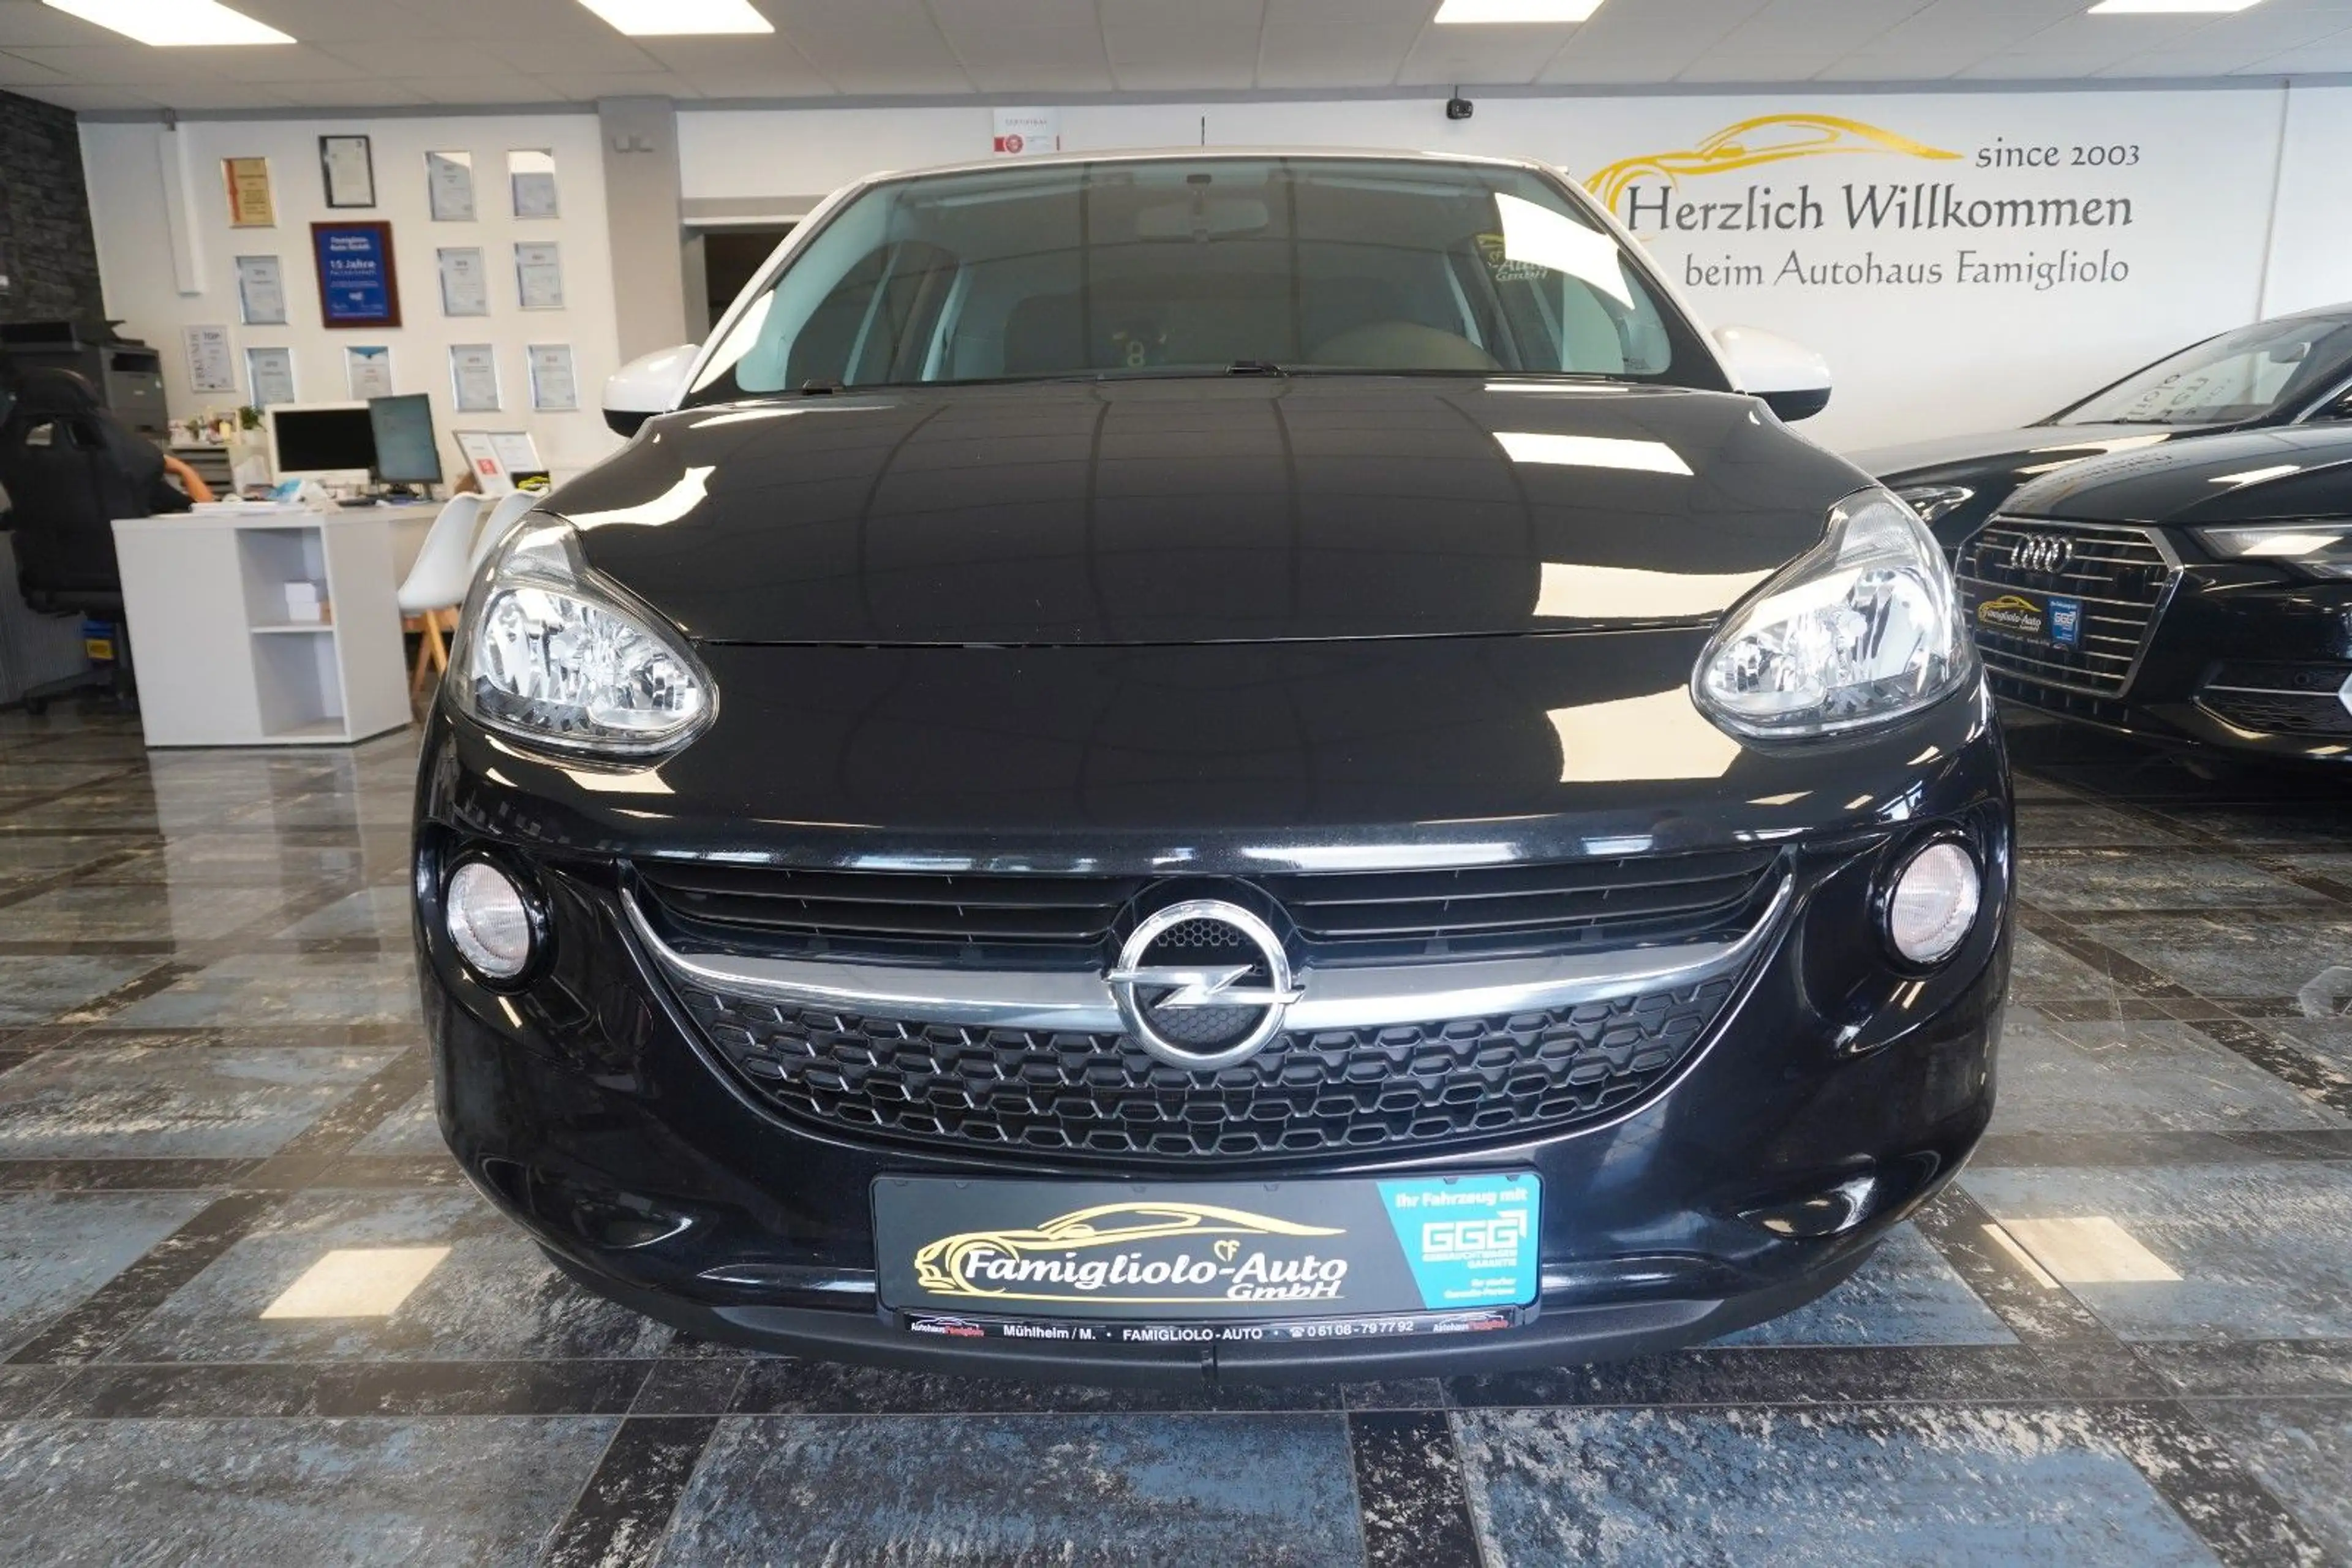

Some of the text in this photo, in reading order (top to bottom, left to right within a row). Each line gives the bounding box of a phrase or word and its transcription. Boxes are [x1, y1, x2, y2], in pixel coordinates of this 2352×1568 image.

[1975, 137, 2140, 168] since 2003
[1628, 183, 2133, 232] Herzlich Willkommen
[1685, 249, 2130, 291] beim Autohaus Famigliolo
[1423, 1218, 1519, 1252] GGG
[965, 1250, 1348, 1290] Famigliolo-Auto
[1226, 1280, 1341, 1301] GmbH
